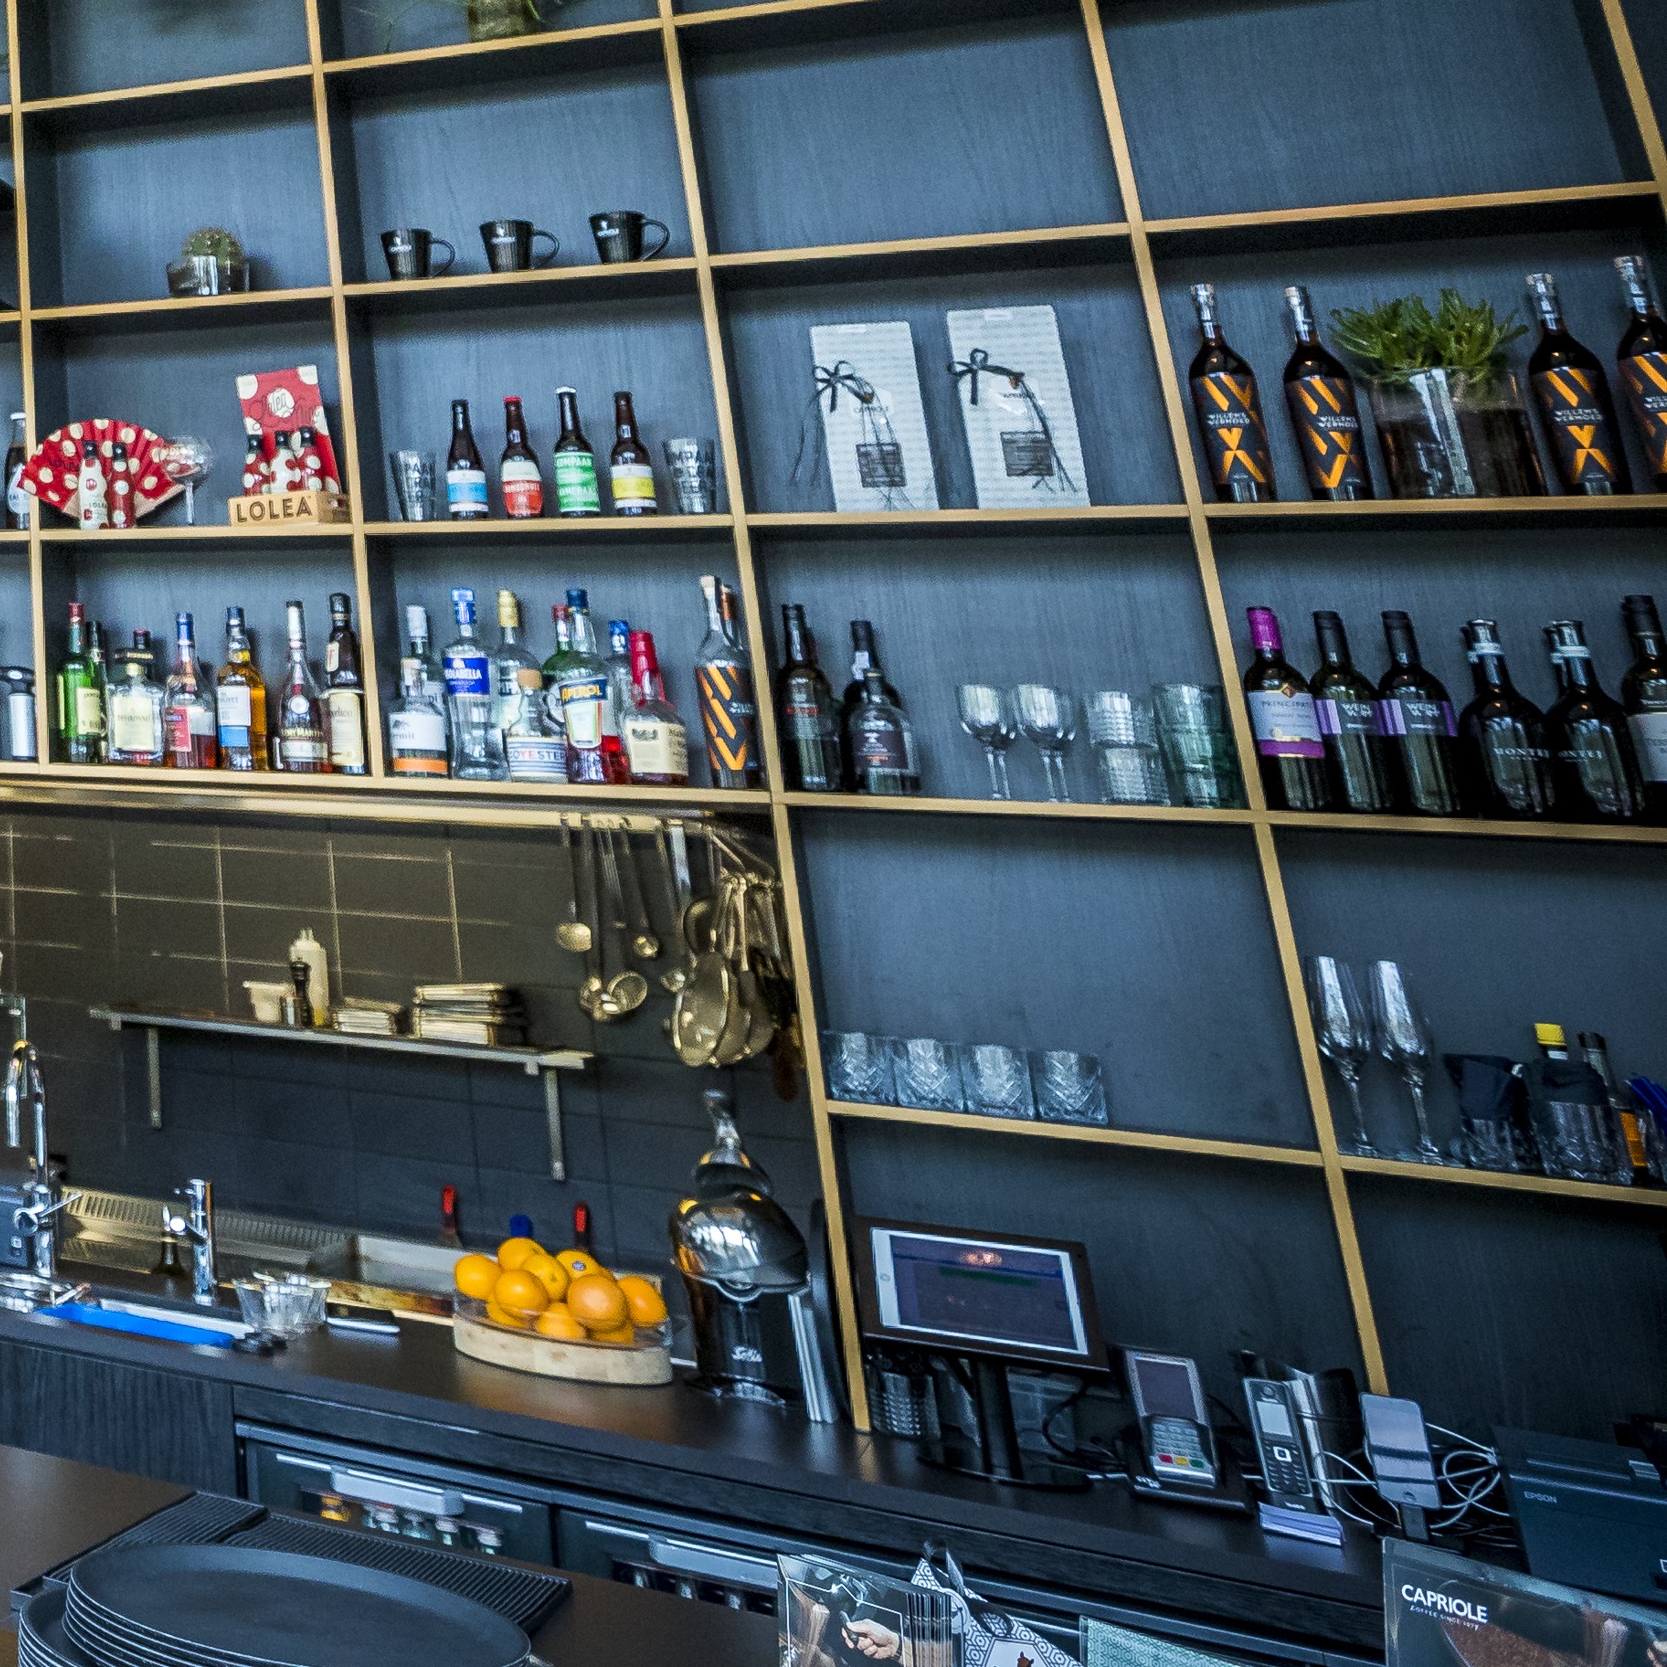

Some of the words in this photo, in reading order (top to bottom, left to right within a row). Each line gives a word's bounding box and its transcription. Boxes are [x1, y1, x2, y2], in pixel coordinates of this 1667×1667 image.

[236, 495, 312, 523] LOLEA
[561, 685, 602, 701] APEROL
[1523, 1490, 1558, 1504] EPSON
[1401, 1584, 1489, 1624] CAPRIOLE
